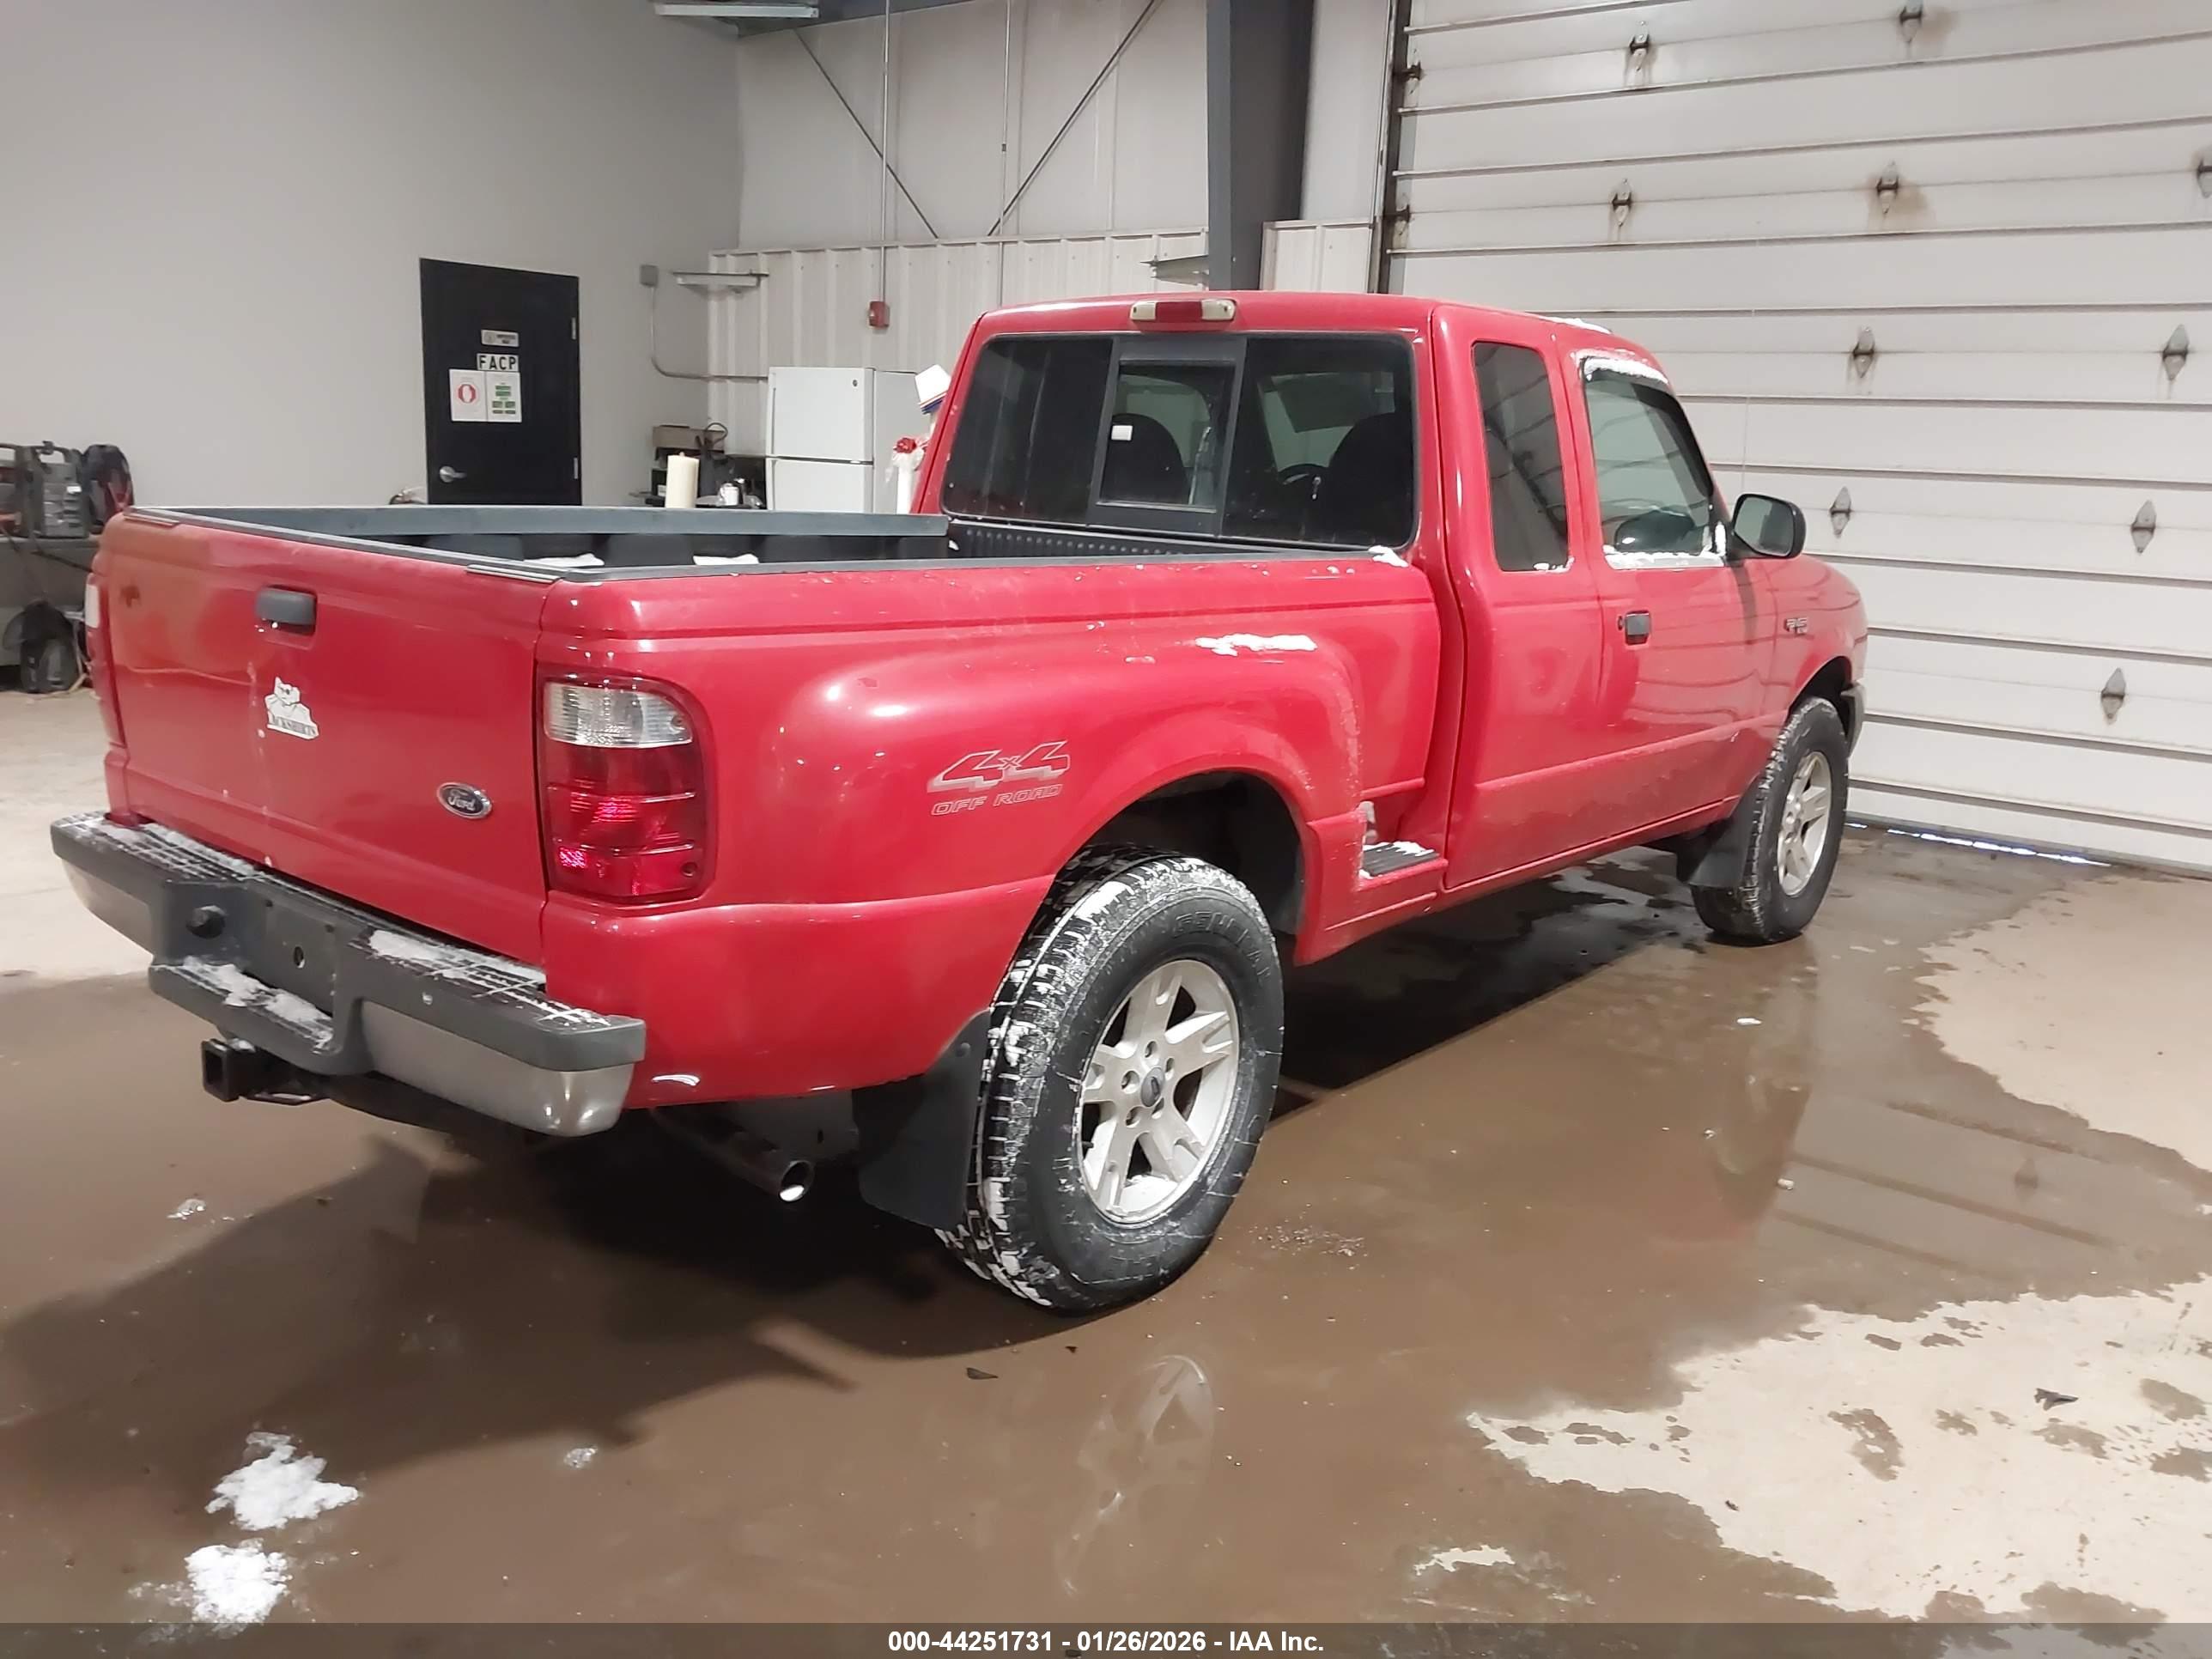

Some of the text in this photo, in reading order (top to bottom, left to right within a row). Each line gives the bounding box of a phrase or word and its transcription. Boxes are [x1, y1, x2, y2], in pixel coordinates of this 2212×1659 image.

[479, 355, 516, 370] FACP
[931, 784, 1063, 816] OFF ROAD
